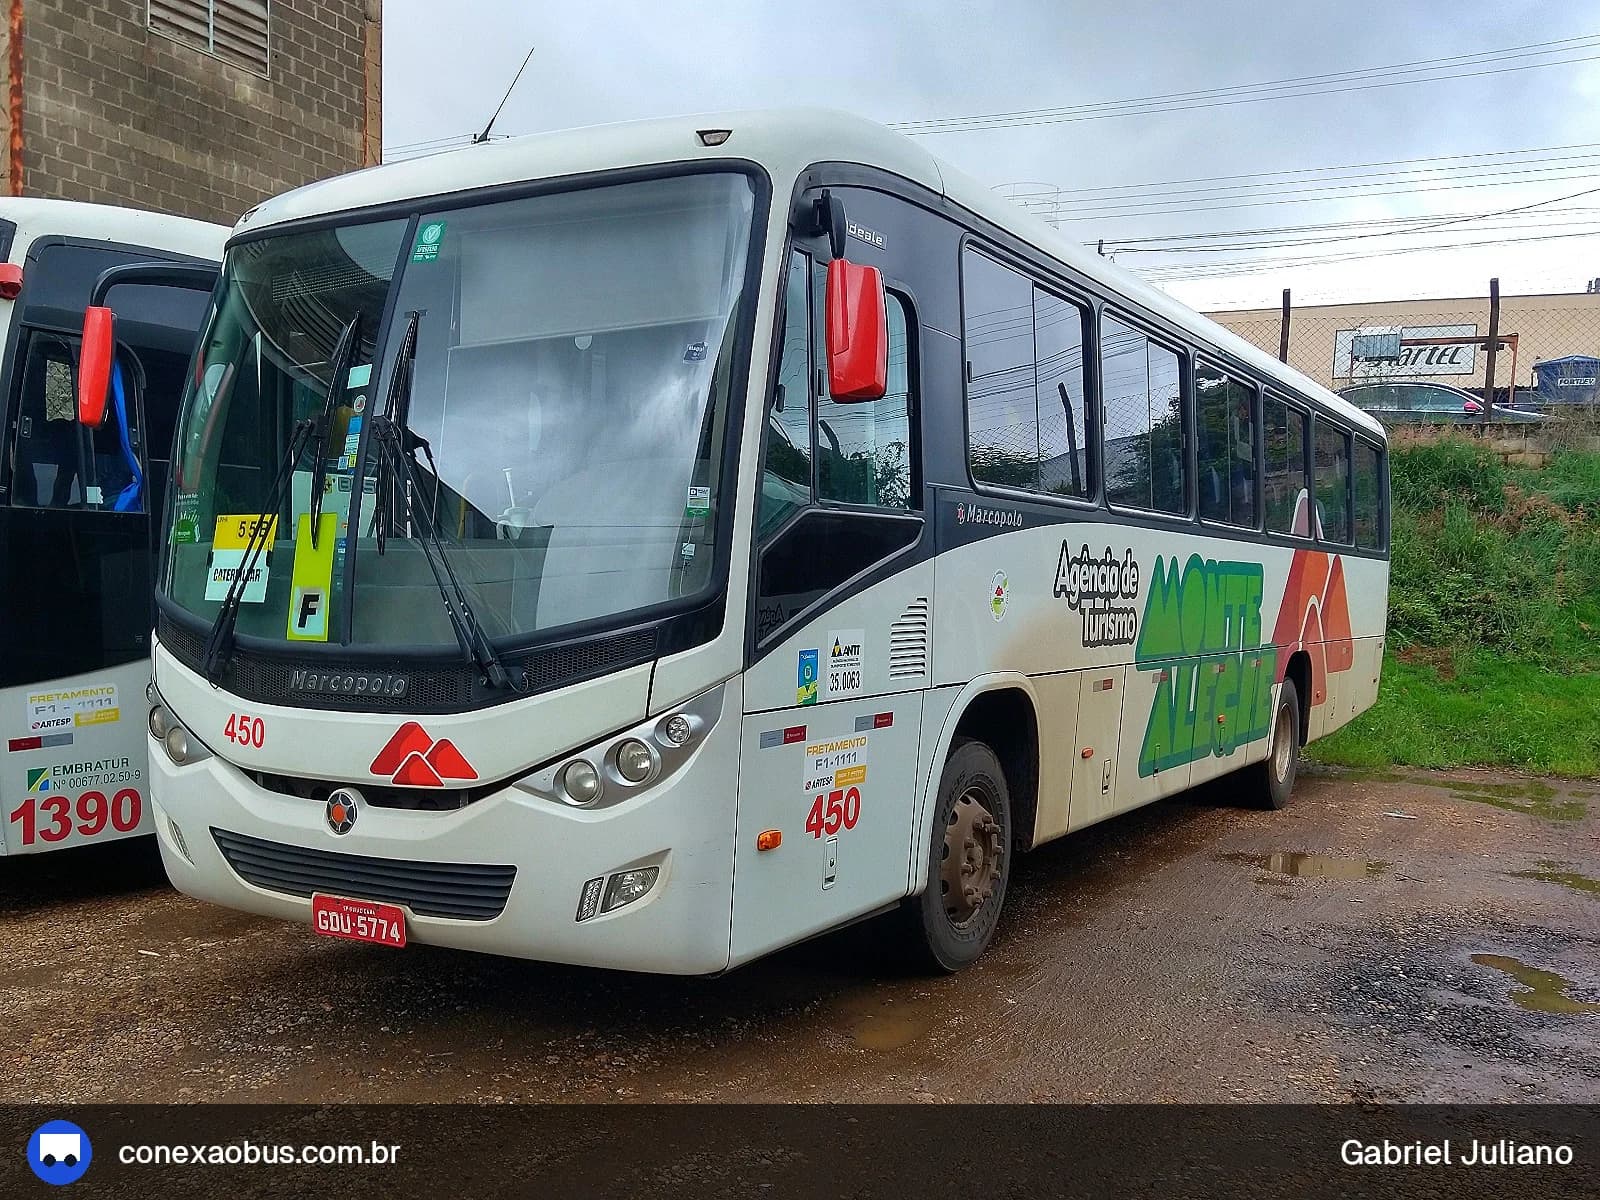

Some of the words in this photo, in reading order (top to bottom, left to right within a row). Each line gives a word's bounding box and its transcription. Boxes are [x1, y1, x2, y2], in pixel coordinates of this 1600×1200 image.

[967, 504, 1023, 527] Marcopolo
[213, 568, 261, 582] CATERLAR
[1054, 539, 1121, 610] Agência
[1121, 548, 1140, 599] de
[298, 594, 320, 628] F
[1135, 553, 1264, 665] MONTE
[1081, 599, 1138, 648] Turismo
[290, 670, 406, 695] Marcopolo
[830, 670, 860, 691] 35.0063
[29, 686, 114, 704] FRETAMENTO
[40, 717, 71, 728] ARTESP
[224, 713, 265, 749] 450
[807, 737, 866, 756] FRETAMENTO
[53, 758, 129, 776] EMBRATUR
[816, 752, 857, 770] F1-1111
[69, 770, 141, 789] 00677.02.50-9
[812, 776, 833, 789] ARTESP
[10, 788, 142, 846] 1390
[806, 787, 860, 839] 450
